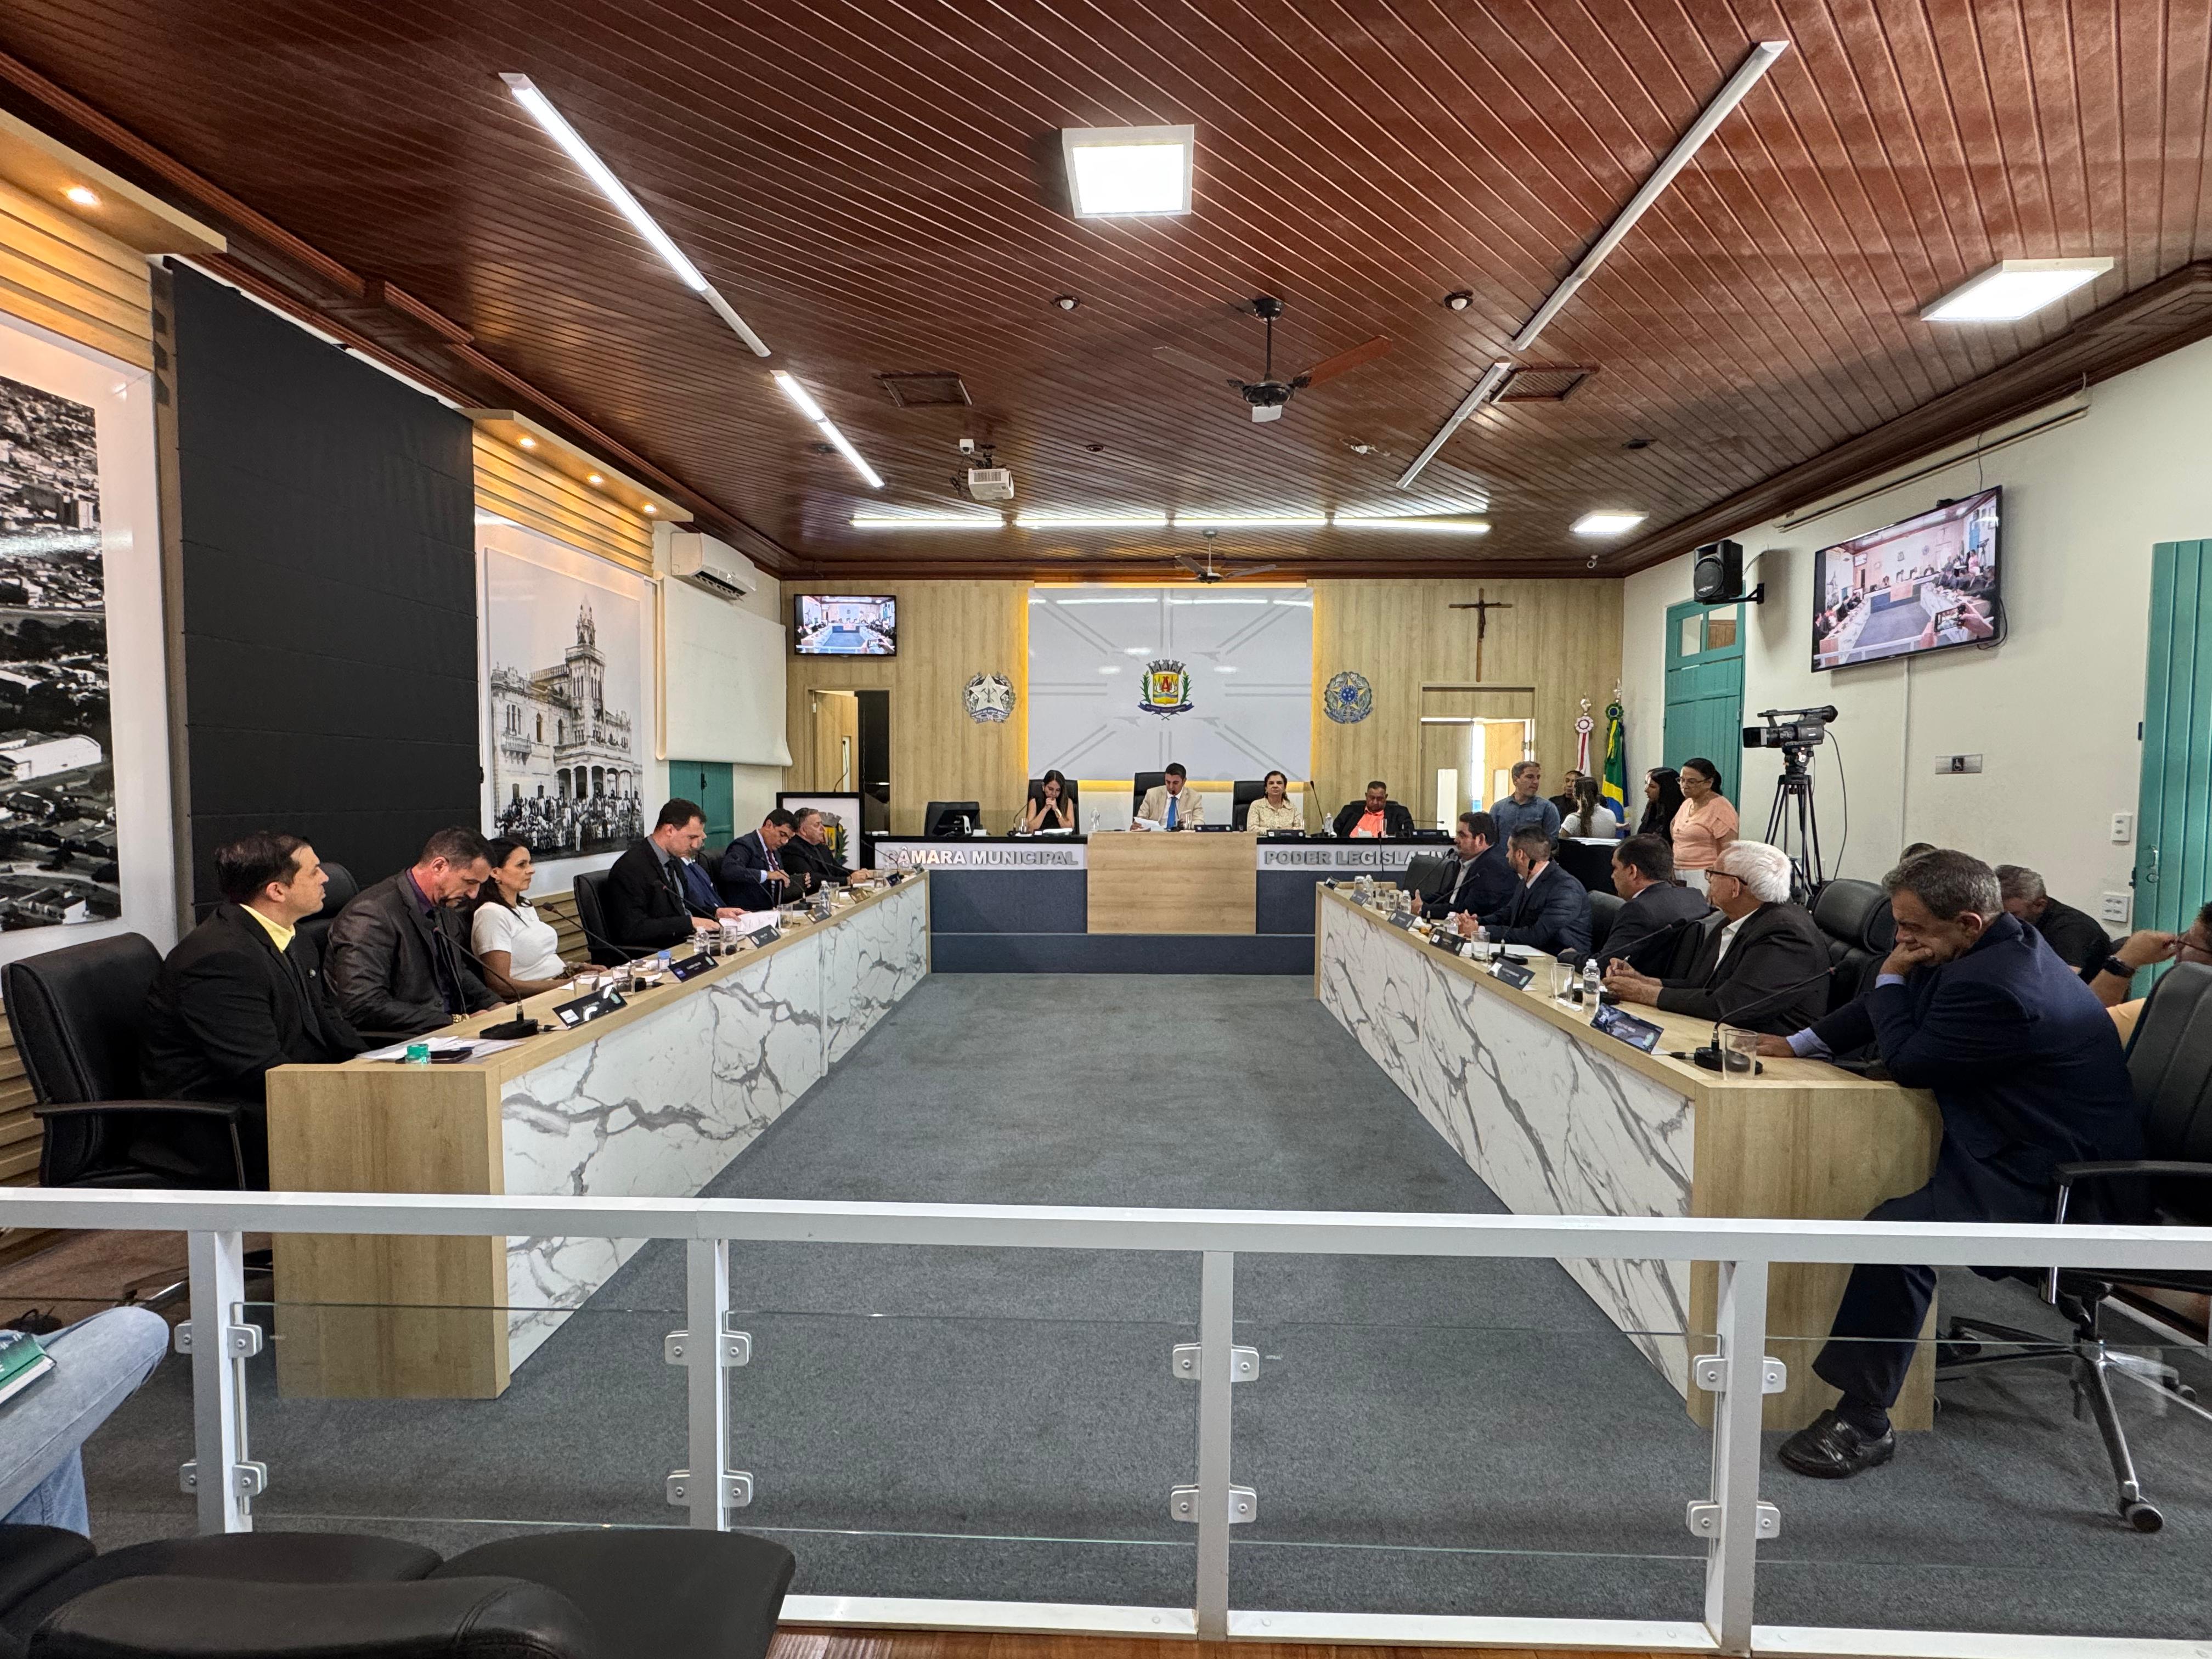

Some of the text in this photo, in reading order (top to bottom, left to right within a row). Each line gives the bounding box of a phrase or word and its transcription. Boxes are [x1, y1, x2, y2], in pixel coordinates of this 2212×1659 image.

[883, 846, 1079, 866] CÂMARA MUNICIPAL
[1264, 850, 1332, 865] PODER
